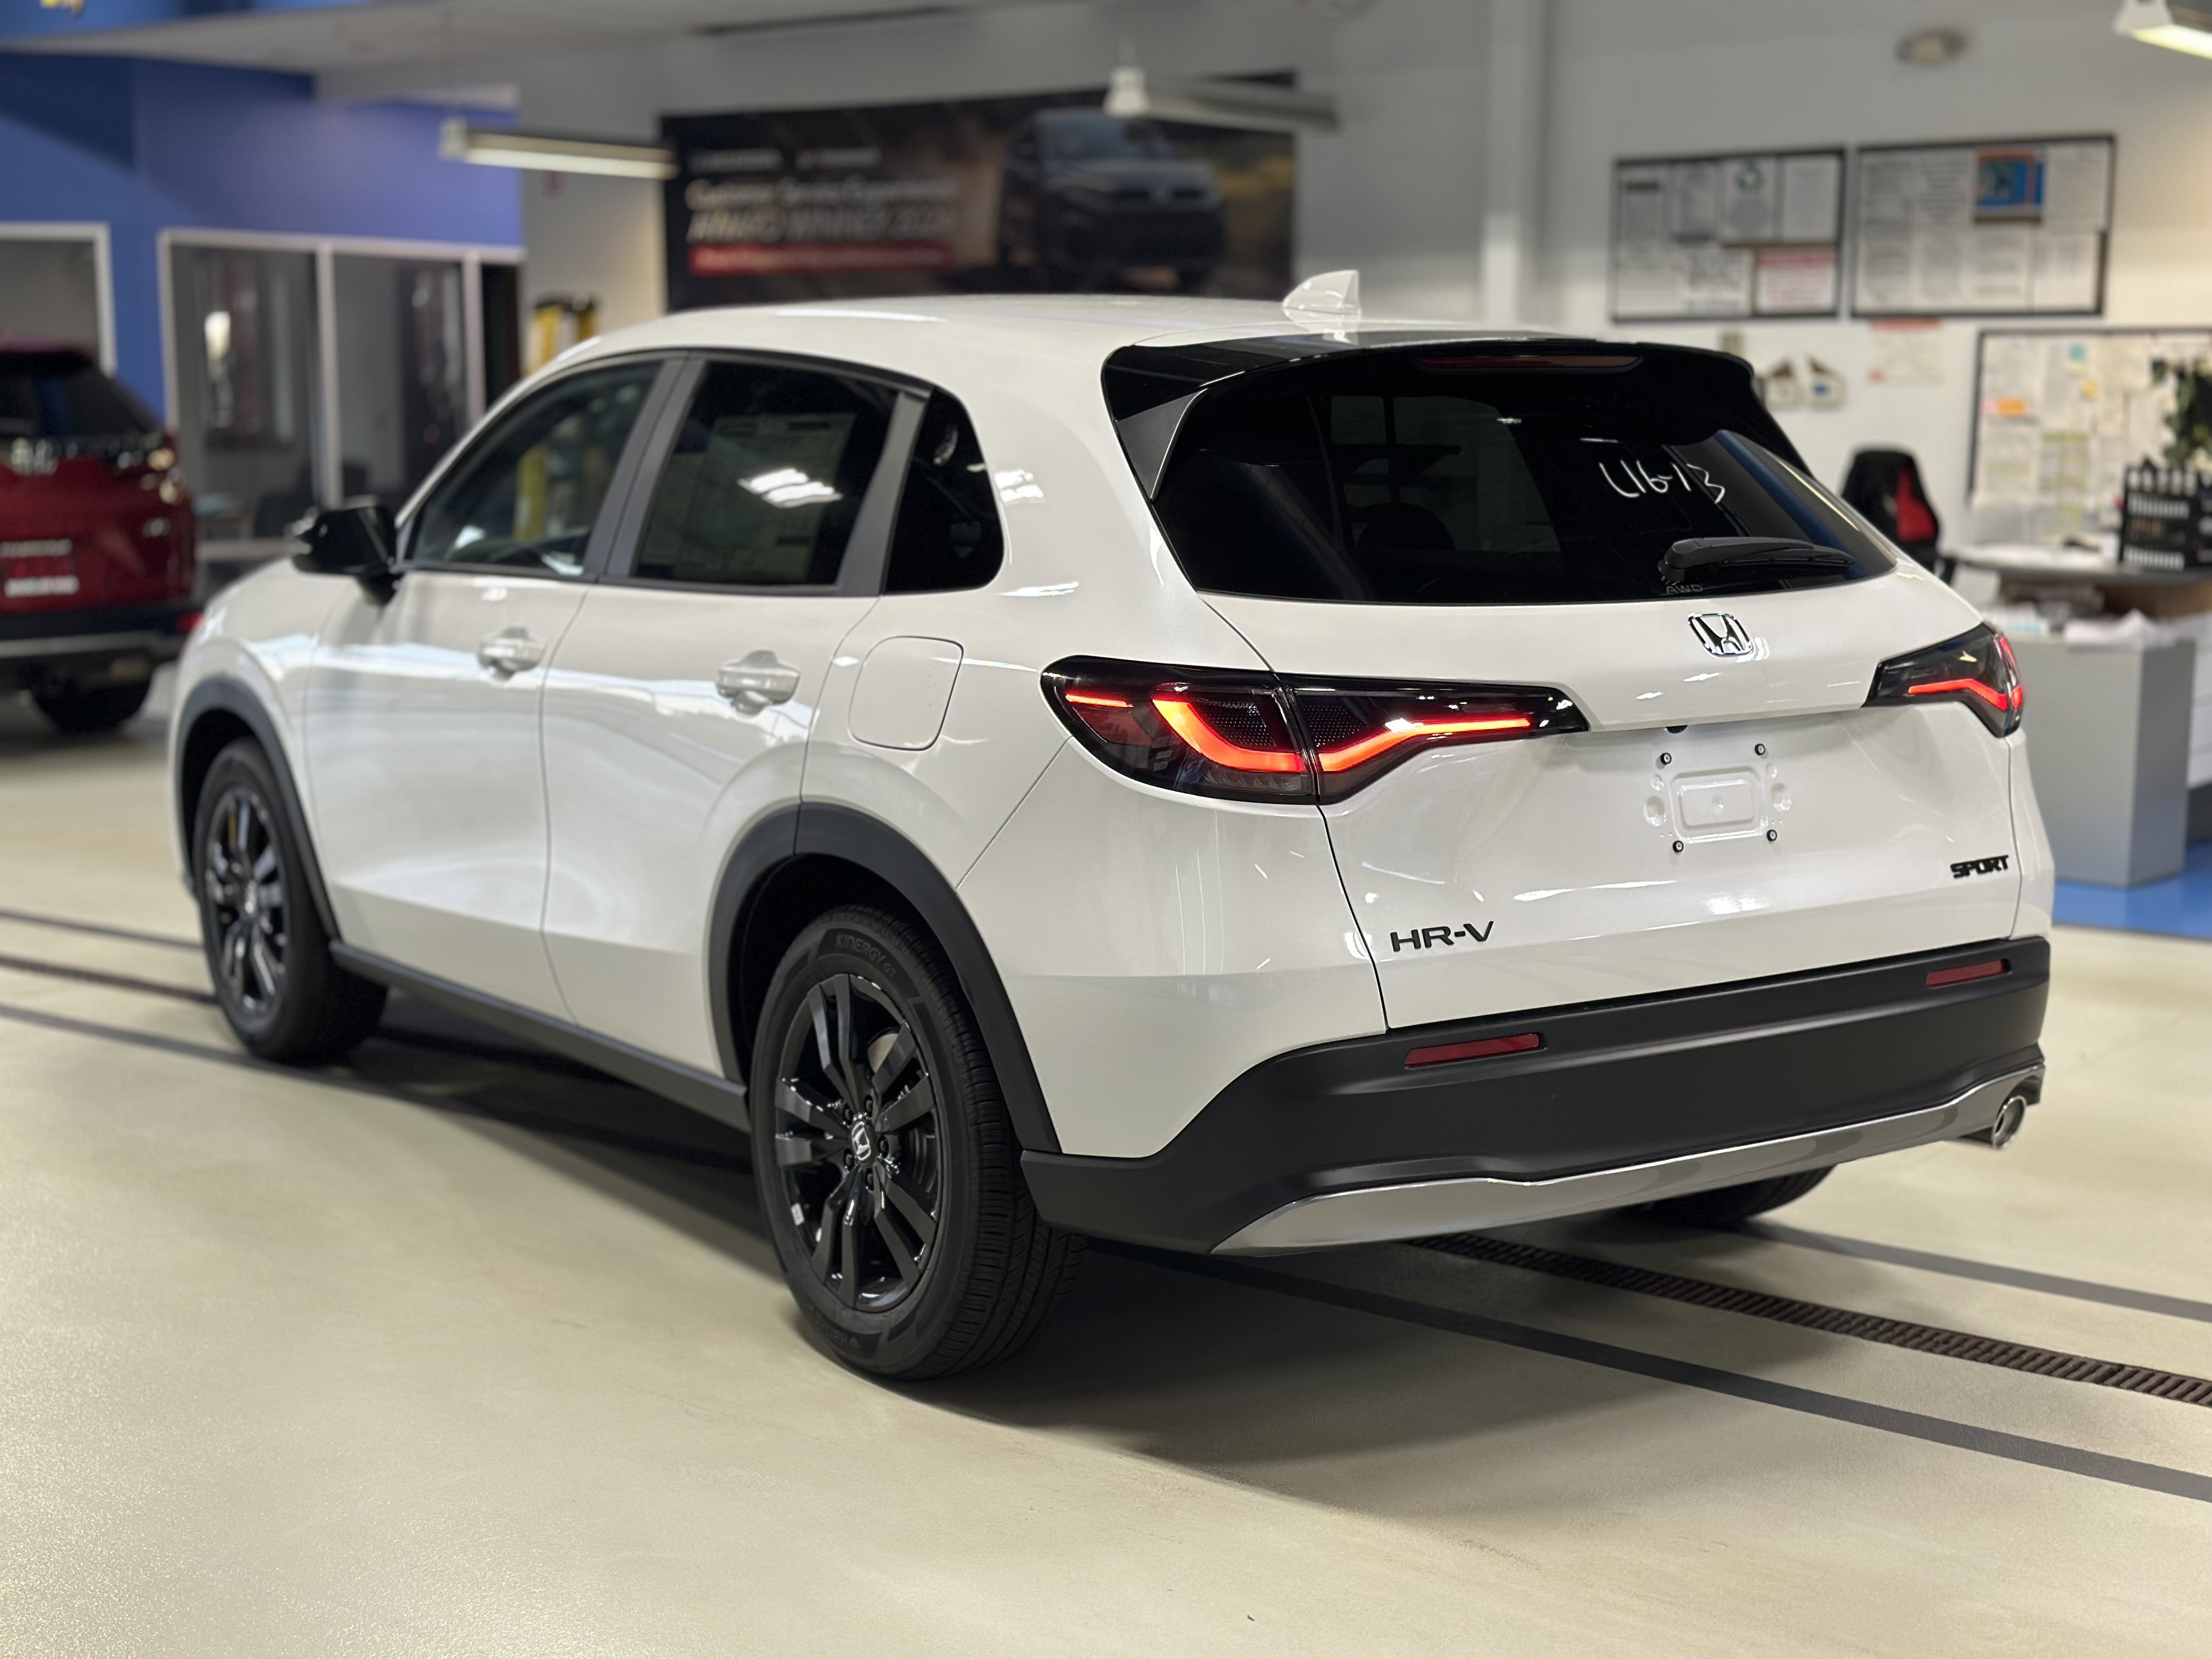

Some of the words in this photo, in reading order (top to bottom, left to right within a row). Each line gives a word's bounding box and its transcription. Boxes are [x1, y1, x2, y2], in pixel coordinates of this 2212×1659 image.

[1666, 584, 1703, 595] AWD
[1950, 854, 2009, 878] SPORT
[1390, 921, 1494, 952] HR-V
